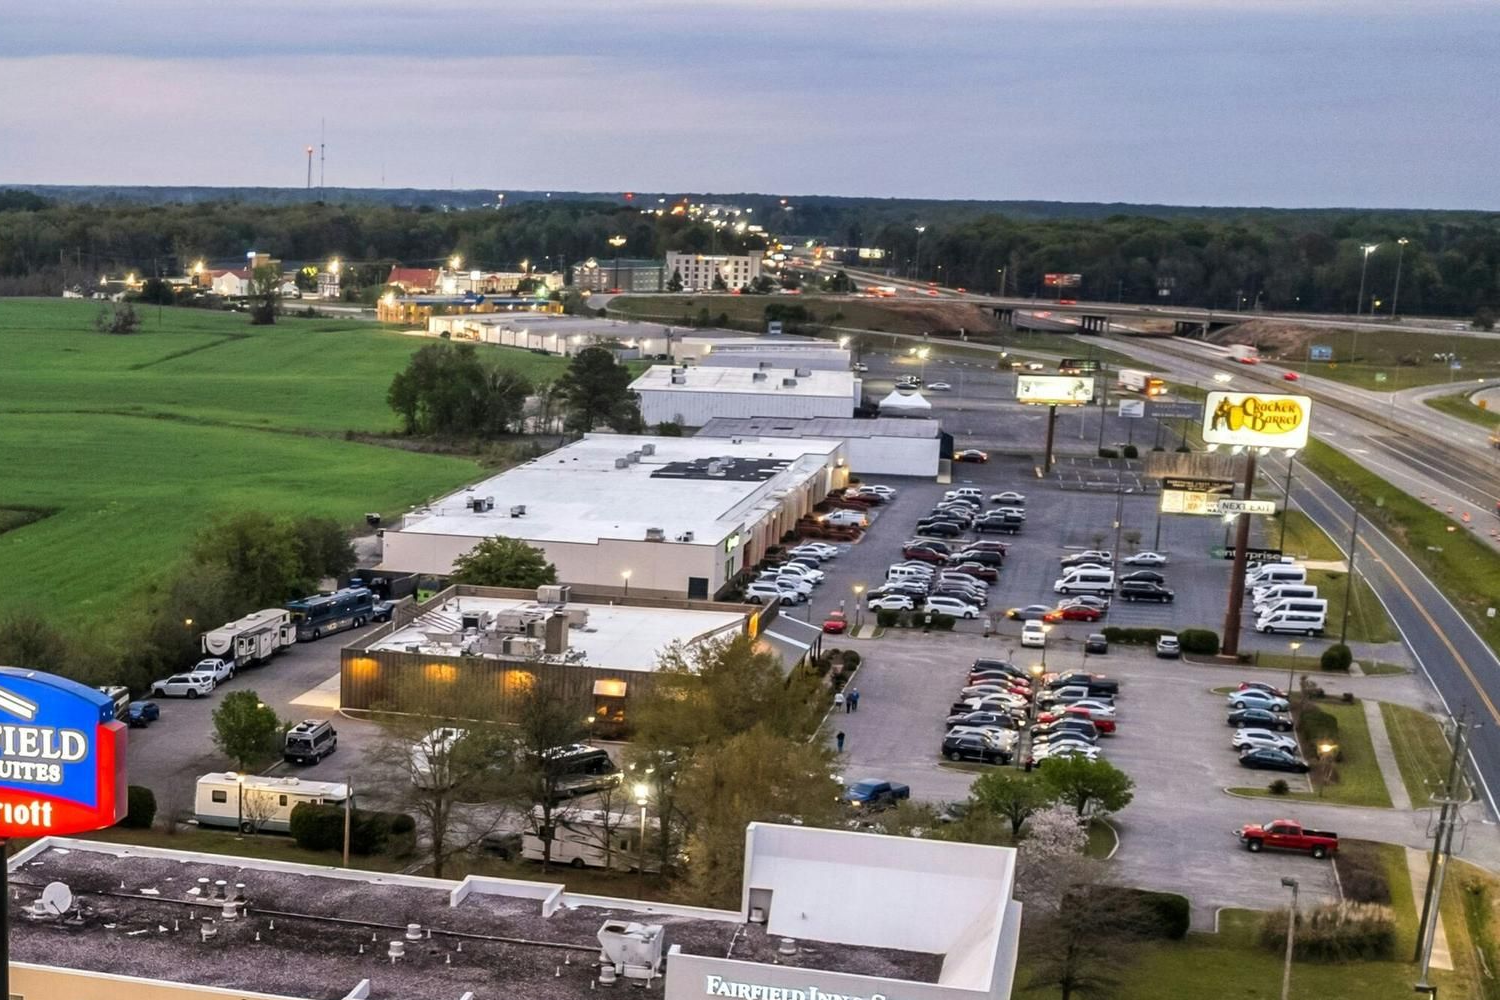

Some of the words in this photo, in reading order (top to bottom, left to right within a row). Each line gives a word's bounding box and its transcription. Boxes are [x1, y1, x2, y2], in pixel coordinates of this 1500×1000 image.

[1242, 397, 1295, 416] Cracker
[1252, 412, 1297, 431] Barrel
[1222, 502, 1246, 510] NEXT
[1211, 549, 1282, 561] entrprise
